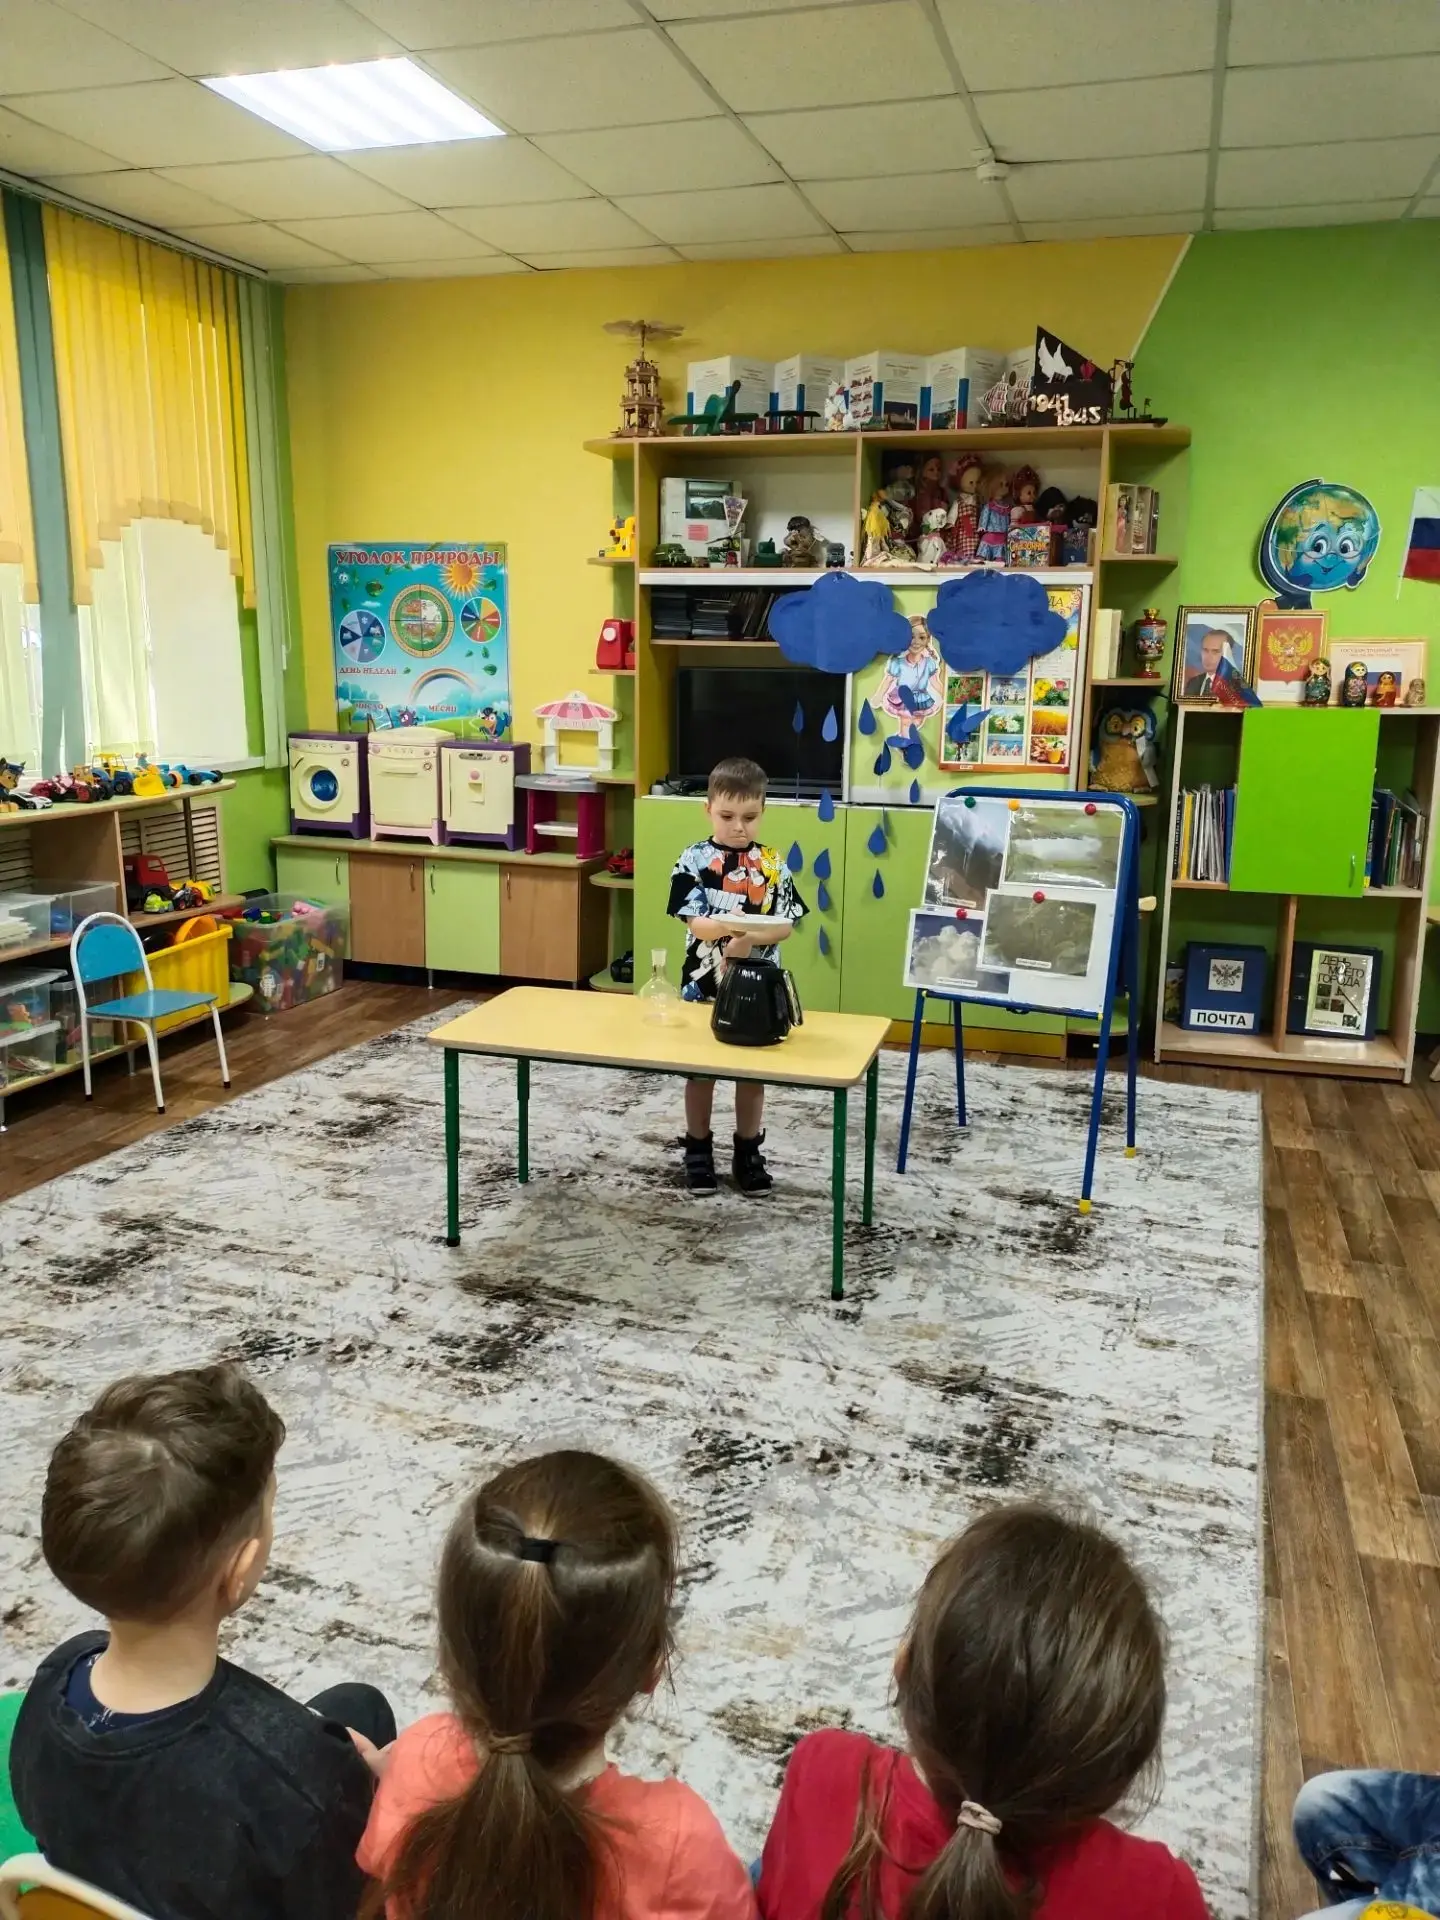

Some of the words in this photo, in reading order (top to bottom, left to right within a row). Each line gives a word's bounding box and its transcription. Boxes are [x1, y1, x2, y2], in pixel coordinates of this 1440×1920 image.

[1029, 393, 1069, 412] 1941
[1054, 407, 1101, 426] 1945
[336, 551, 405, 565] УГОЛОК
[410, 551, 500, 565] ПРИРОДЫ
[363, 667, 397, 675] НЕДЕЛИ
[1321, 955, 1351, 967] ДЕНЬ
[1329, 966, 1365, 978] МОЕГО
[1318, 973, 1361, 988] ГОРОДА
[1197, 1012, 1246, 1026] ПОЧТА
